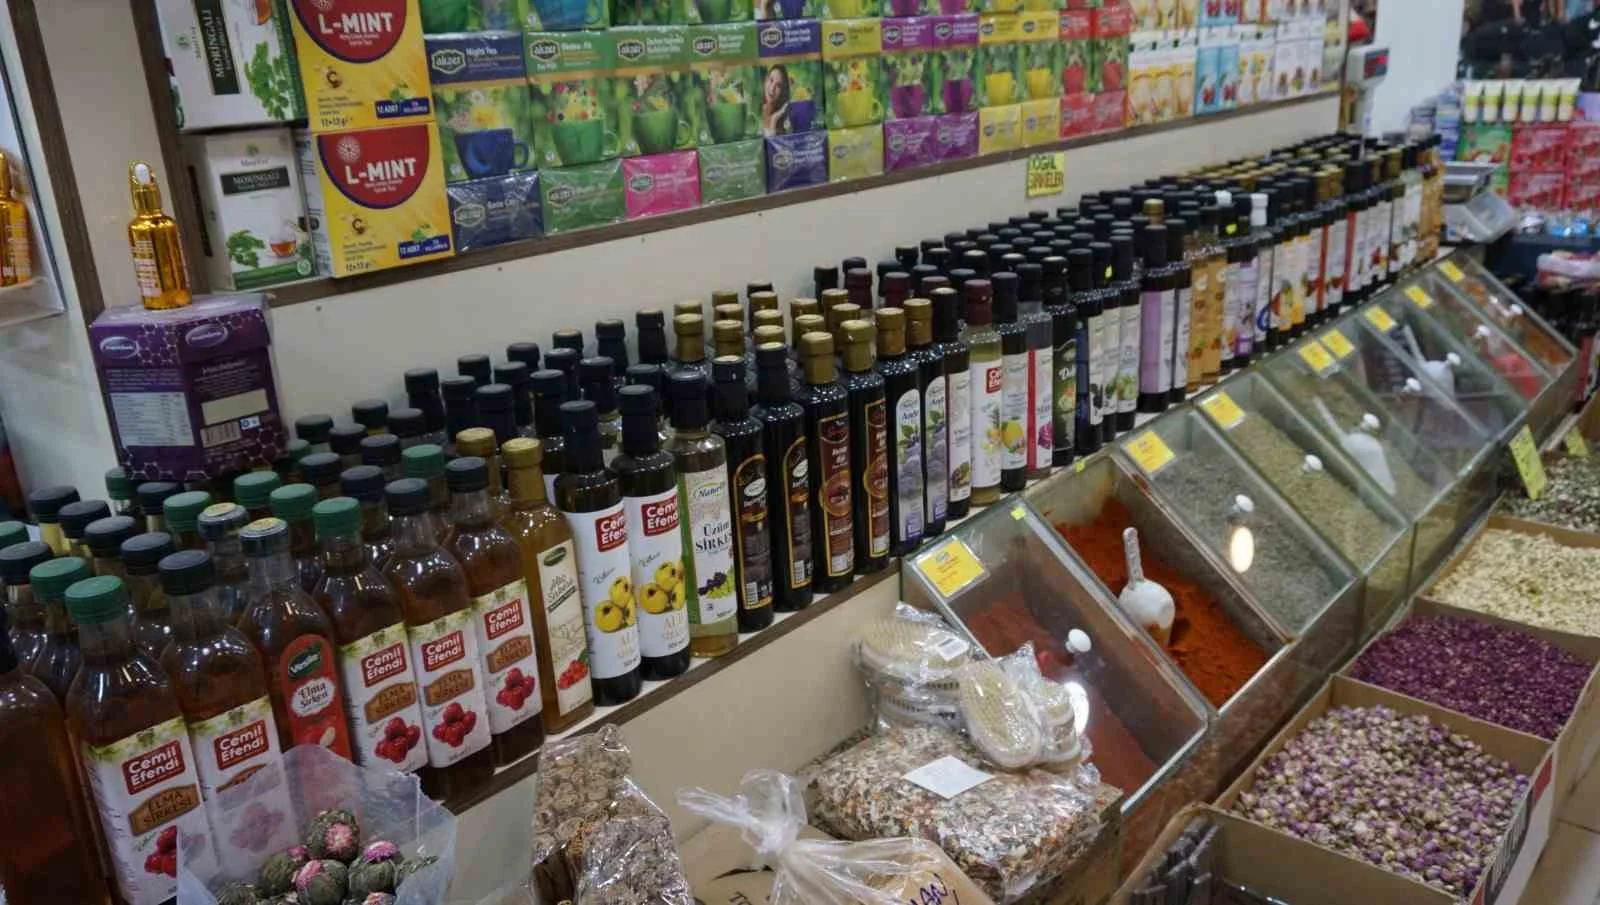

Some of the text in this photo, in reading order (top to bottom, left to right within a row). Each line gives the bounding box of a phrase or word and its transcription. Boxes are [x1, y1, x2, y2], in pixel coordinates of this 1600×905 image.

[319, 12, 393, 34] L-MINT
[345, 157, 417, 185] L-MINT
[488, 602, 520, 623] Cemil
[489, 613, 521, 634] Efendi
[426, 634, 461, 656] Cemil
[427, 644, 462, 666] Efendi
[365, 647, 401, 669] Cemil
[367, 657, 403, 680] Efendi
[219, 724, 263, 750] Cemil
[221, 735, 264, 762] Efendi
[128, 746, 178, 774] Cemil
[130, 756, 181, 786] Efendi
